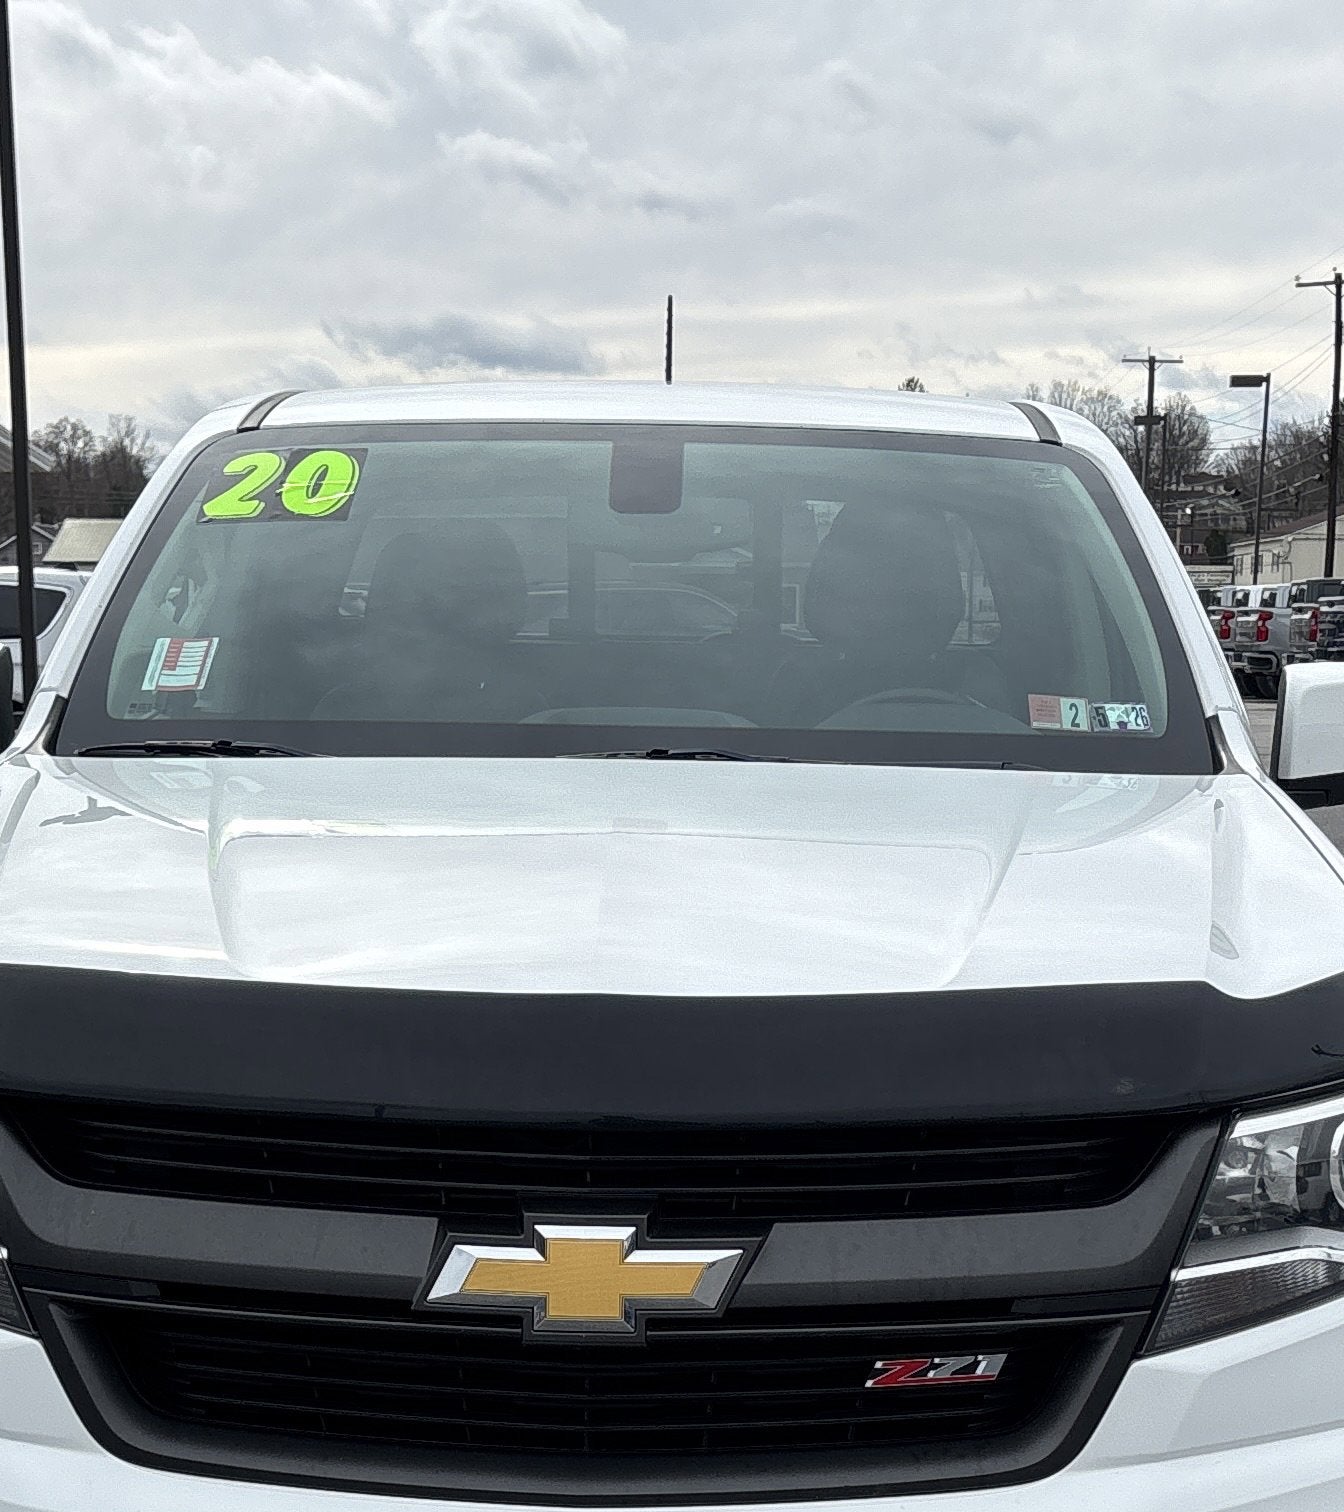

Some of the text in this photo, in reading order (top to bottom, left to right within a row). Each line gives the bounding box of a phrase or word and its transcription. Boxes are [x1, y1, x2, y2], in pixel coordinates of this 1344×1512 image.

[202, 450, 360, 520] 20
[1068, 702, 1081, 729] 2
[1130, 706, 1150, 729] 26
[864, 1353, 1008, 1388] Z71
